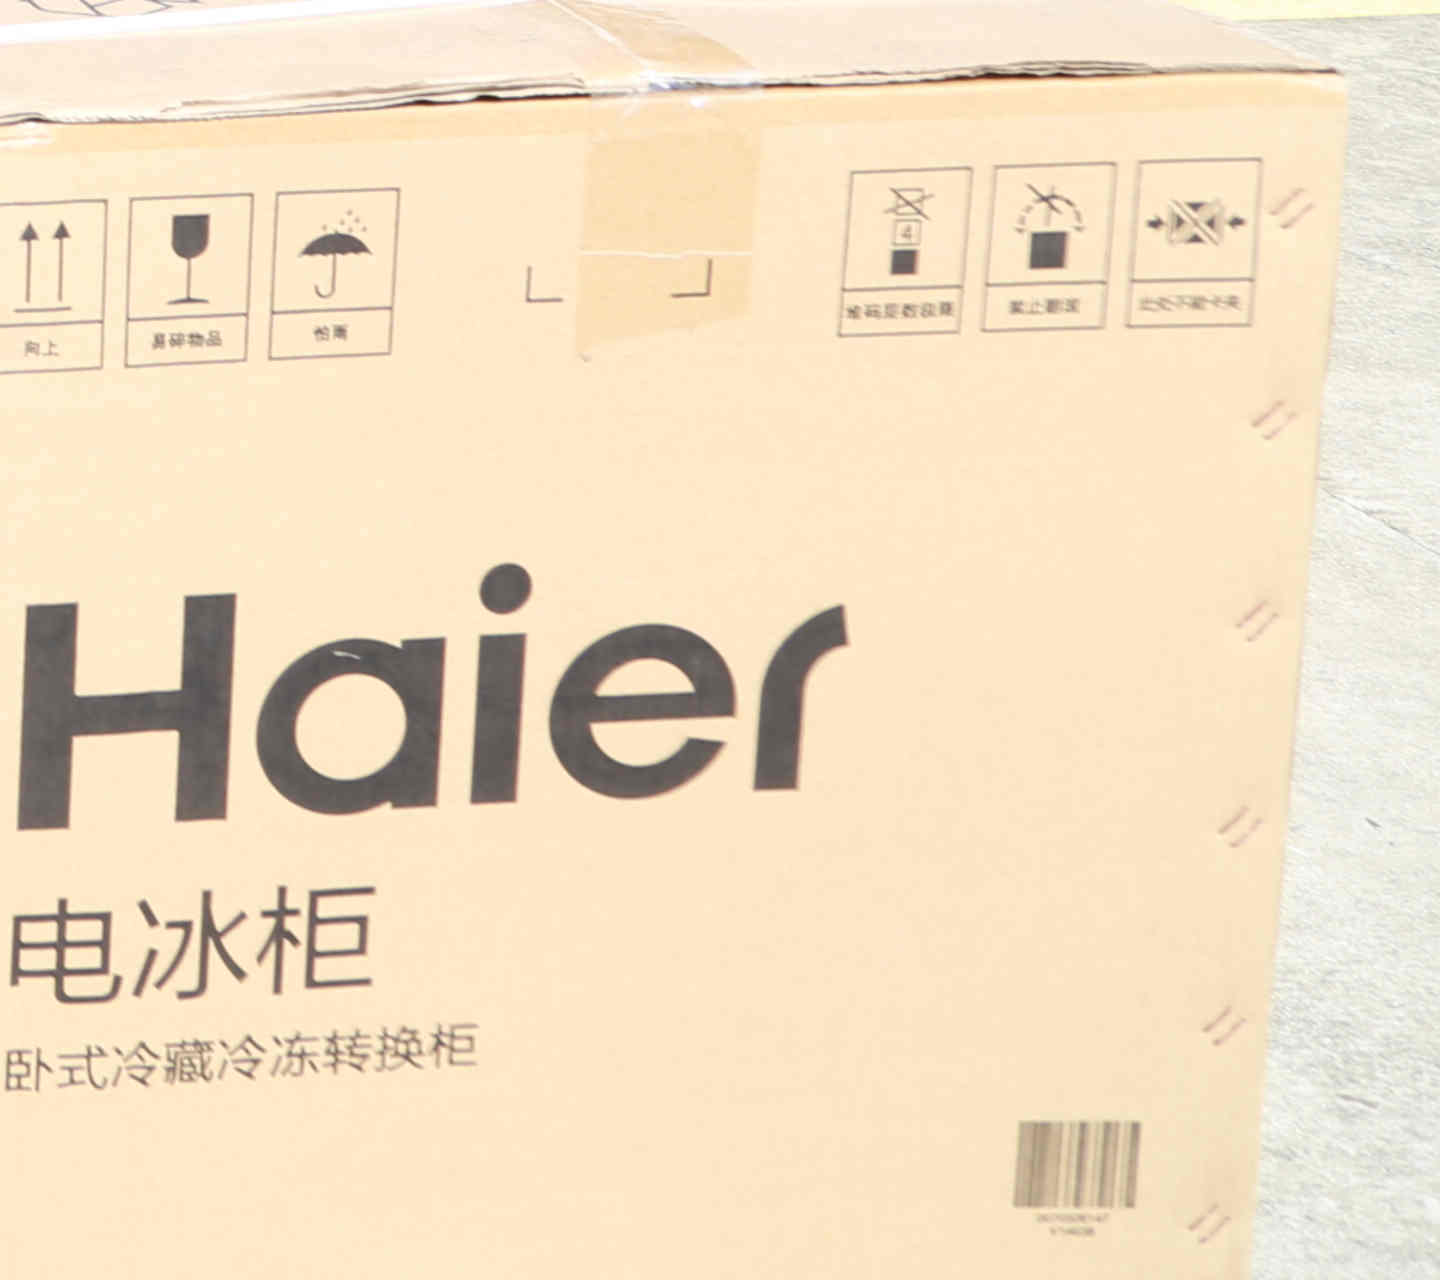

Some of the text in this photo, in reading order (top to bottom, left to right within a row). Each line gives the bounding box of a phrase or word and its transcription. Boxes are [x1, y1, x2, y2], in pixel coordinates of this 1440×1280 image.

[23, 338, 60, 358] 向上
[16, 562, 850, 831] Haier
[10, 885, 376, 1005] 电冰柜
[4, 1022, 480, 1094] 卧式冷藏冷冻转换柜
